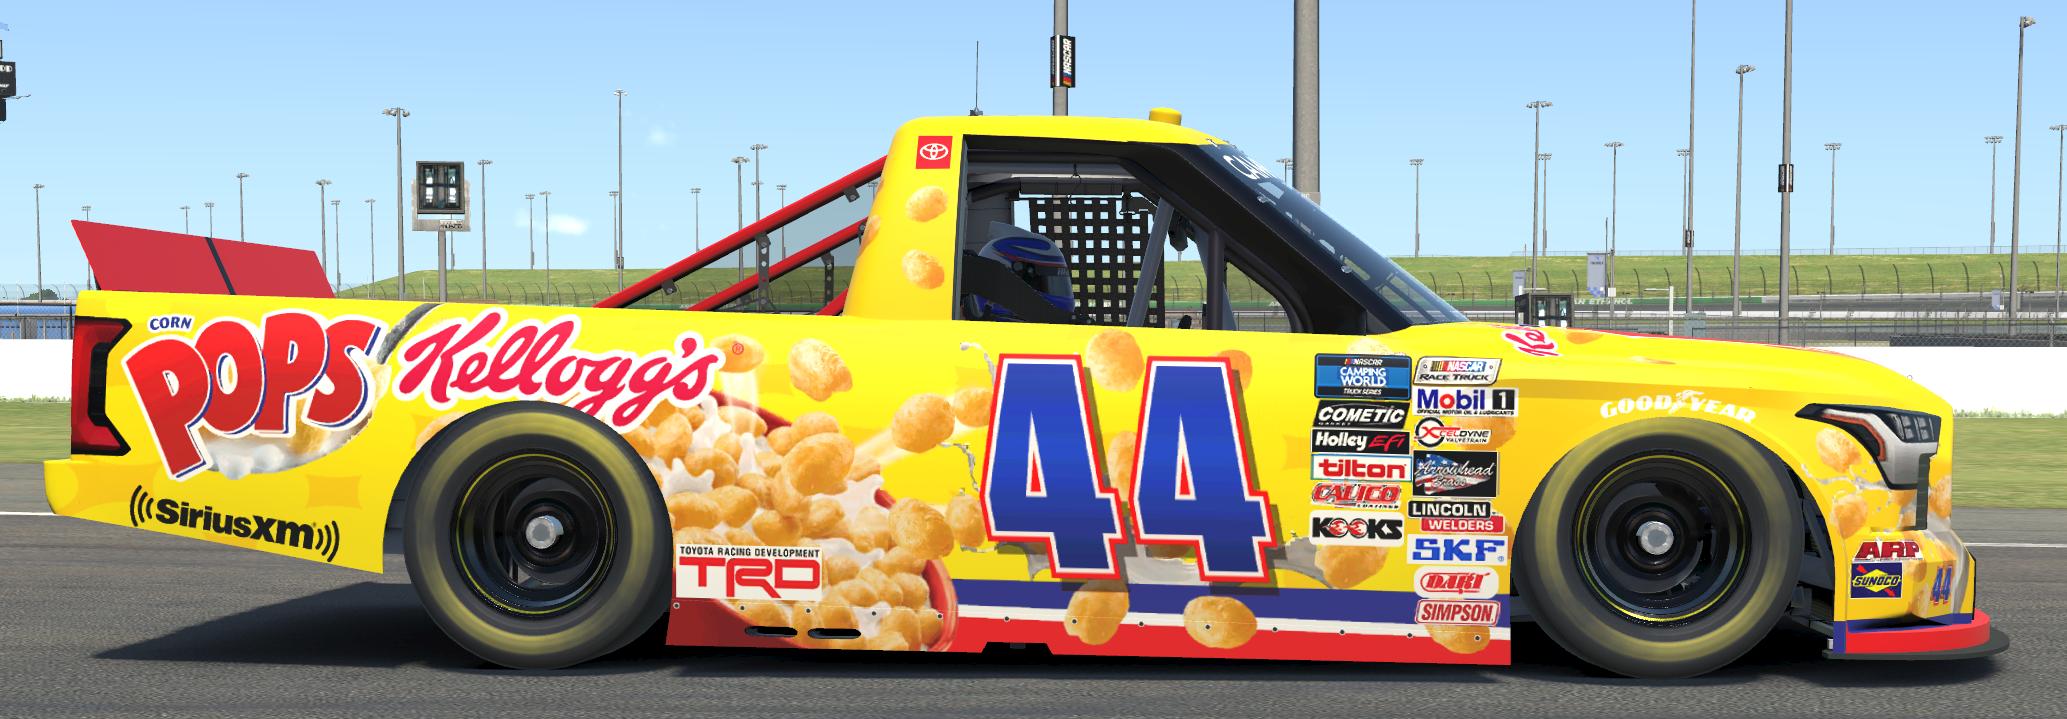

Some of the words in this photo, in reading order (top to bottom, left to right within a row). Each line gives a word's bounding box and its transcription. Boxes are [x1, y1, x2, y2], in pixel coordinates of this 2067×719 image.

[150, 317, 192, 330] CORN
[398, 311, 719, 427] Kellogg's
[1351, 358, 1383, 366] NASCAR
[1447, 361, 1484, 370] NASCAR
[1340, 366, 1387, 377] CAMPING
[1420, 373, 1451, 381] RACE
[1453, 373, 1489, 381] TRUCK
[1340, 376, 1387, 387] WORLD
[122, 310, 386, 481] POPS
[1417, 388, 1485, 410] Mobil
[1318, 405, 1406, 424] COMETIC
[1315, 431, 1367, 450] Holley
[980, 353, 1278, 583] 44
[1319, 459, 1406, 479] tilton
[1414, 460, 1496, 476] Arrowhead
[1313, 484, 1401, 502] CALICO
[1412, 503, 1487, 516] LINCOLN
[1312, 517, 1403, 540] KOOKS
[1428, 518, 1494, 531] WELDERS
[679, 546, 714, 556] TOYOTA
[717, 547, 751, 557] RACING
[754, 548, 820, 558] DEVELOPMENT
[1412, 538, 1505, 562] SKF
[1855, 541, 1920, 558] ARP
[679, 556, 821, 598] TRD
[1425, 572, 1490, 594] DART
[1854, 575, 1900, 587] SUNOCO
[1931, 565, 1953, 605] 44
[1421, 603, 1493, 621] SIMPSON
